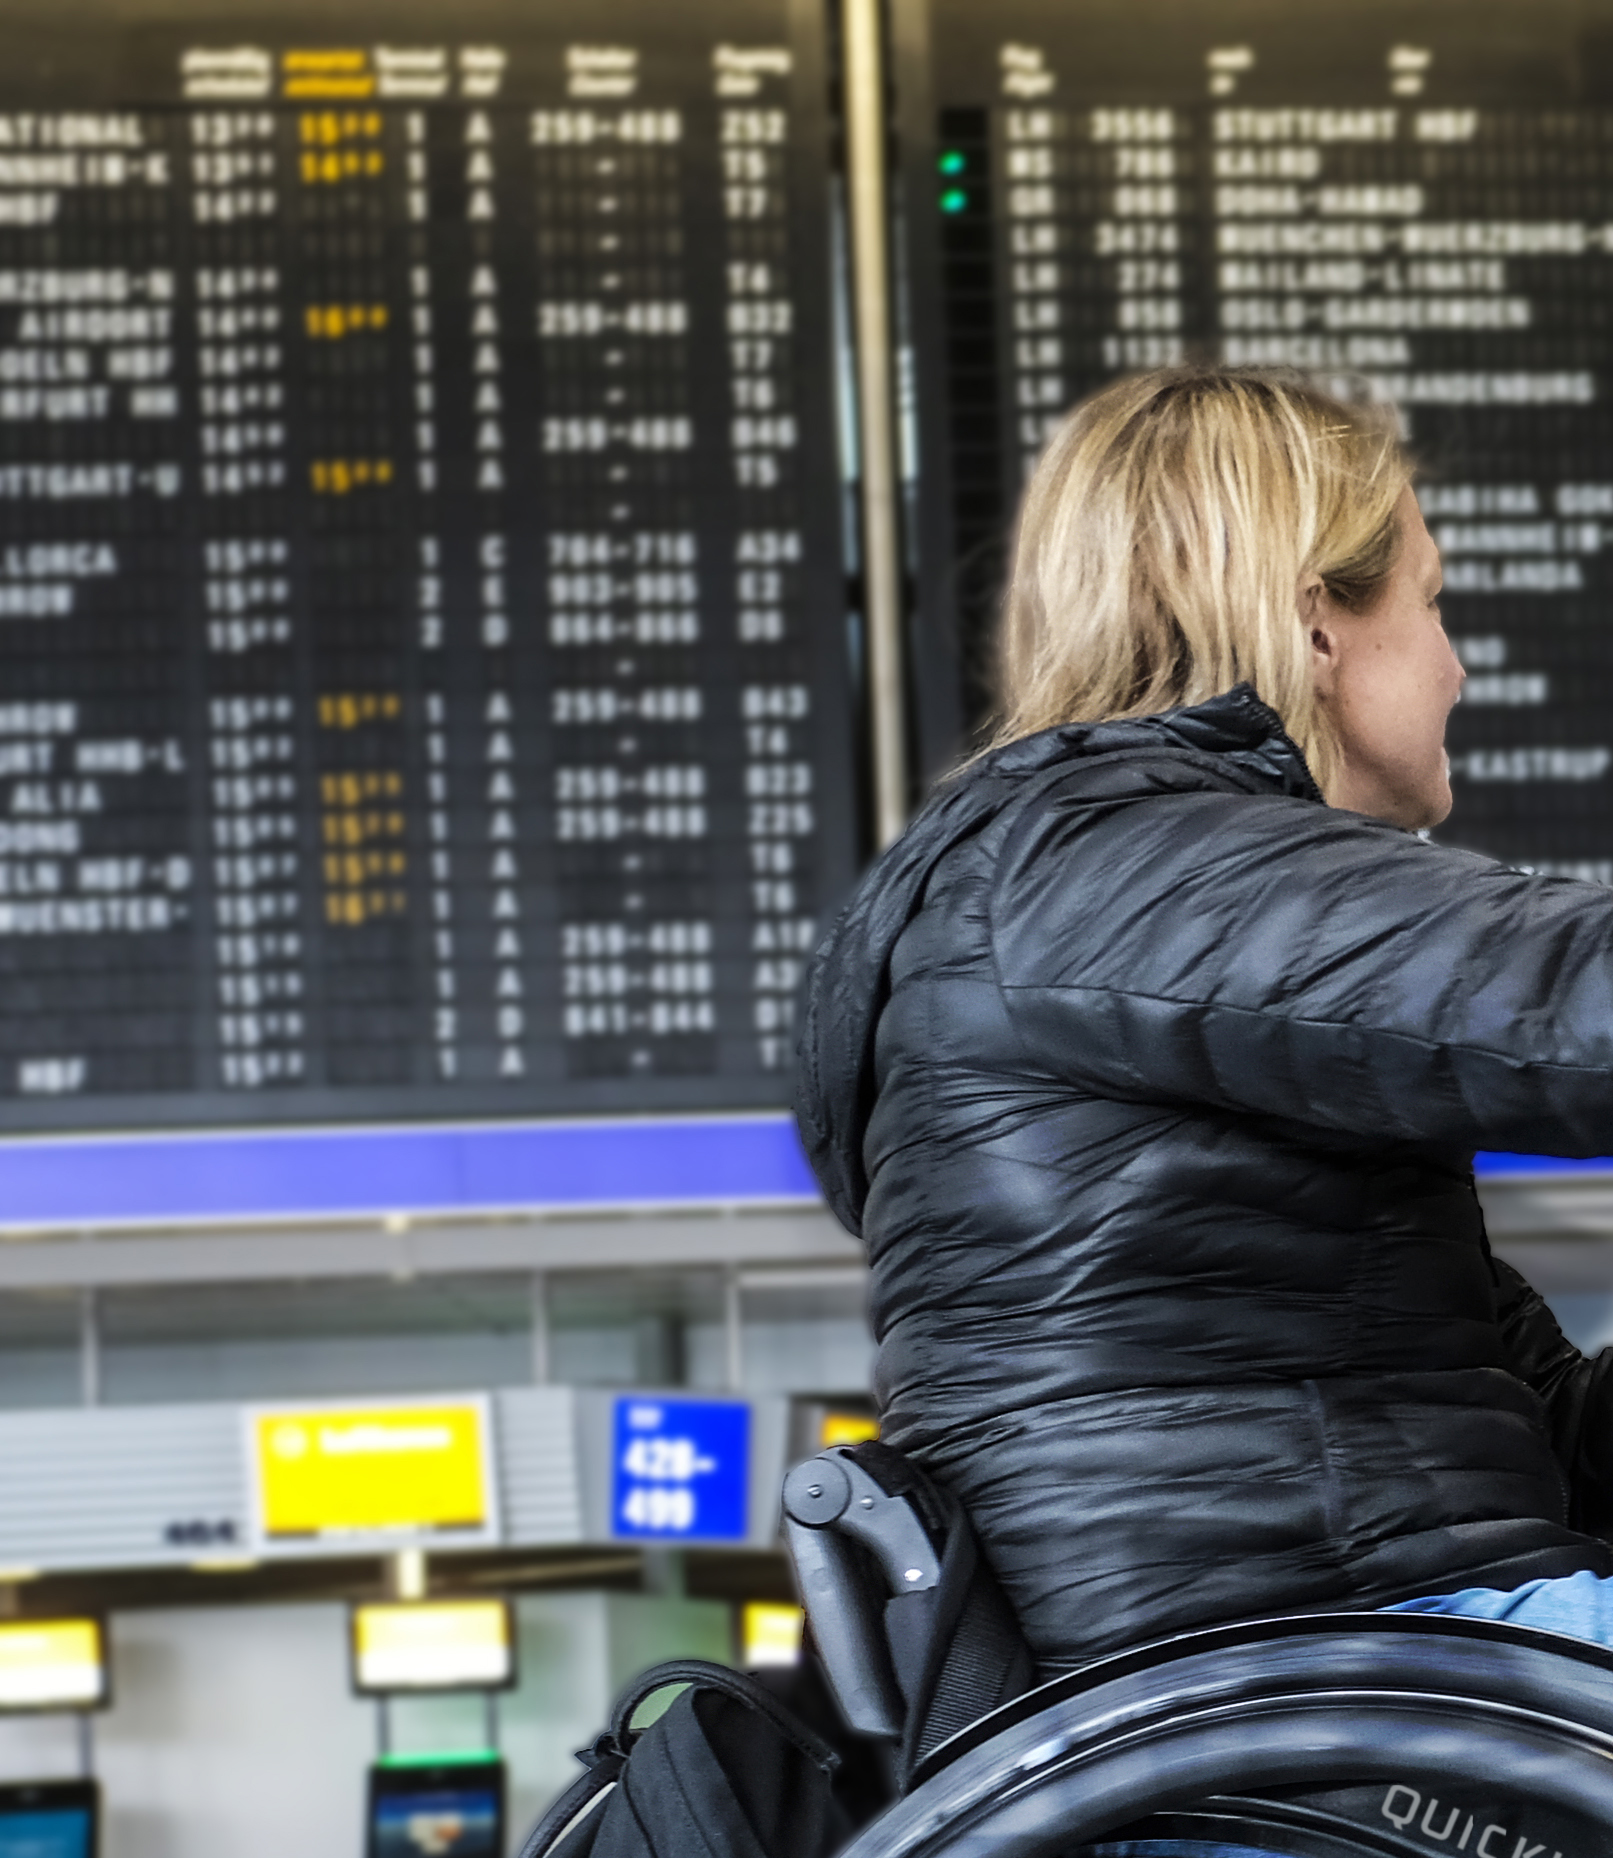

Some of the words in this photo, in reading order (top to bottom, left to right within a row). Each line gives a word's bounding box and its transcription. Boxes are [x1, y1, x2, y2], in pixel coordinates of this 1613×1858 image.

[1215, 109, 1396, 141] STUTTGART
[1214, 148, 1319, 177] KAIRO
[729, 262, 770, 293] T4
[1219, 260, 1503, 291] MAILAND-LINATE
